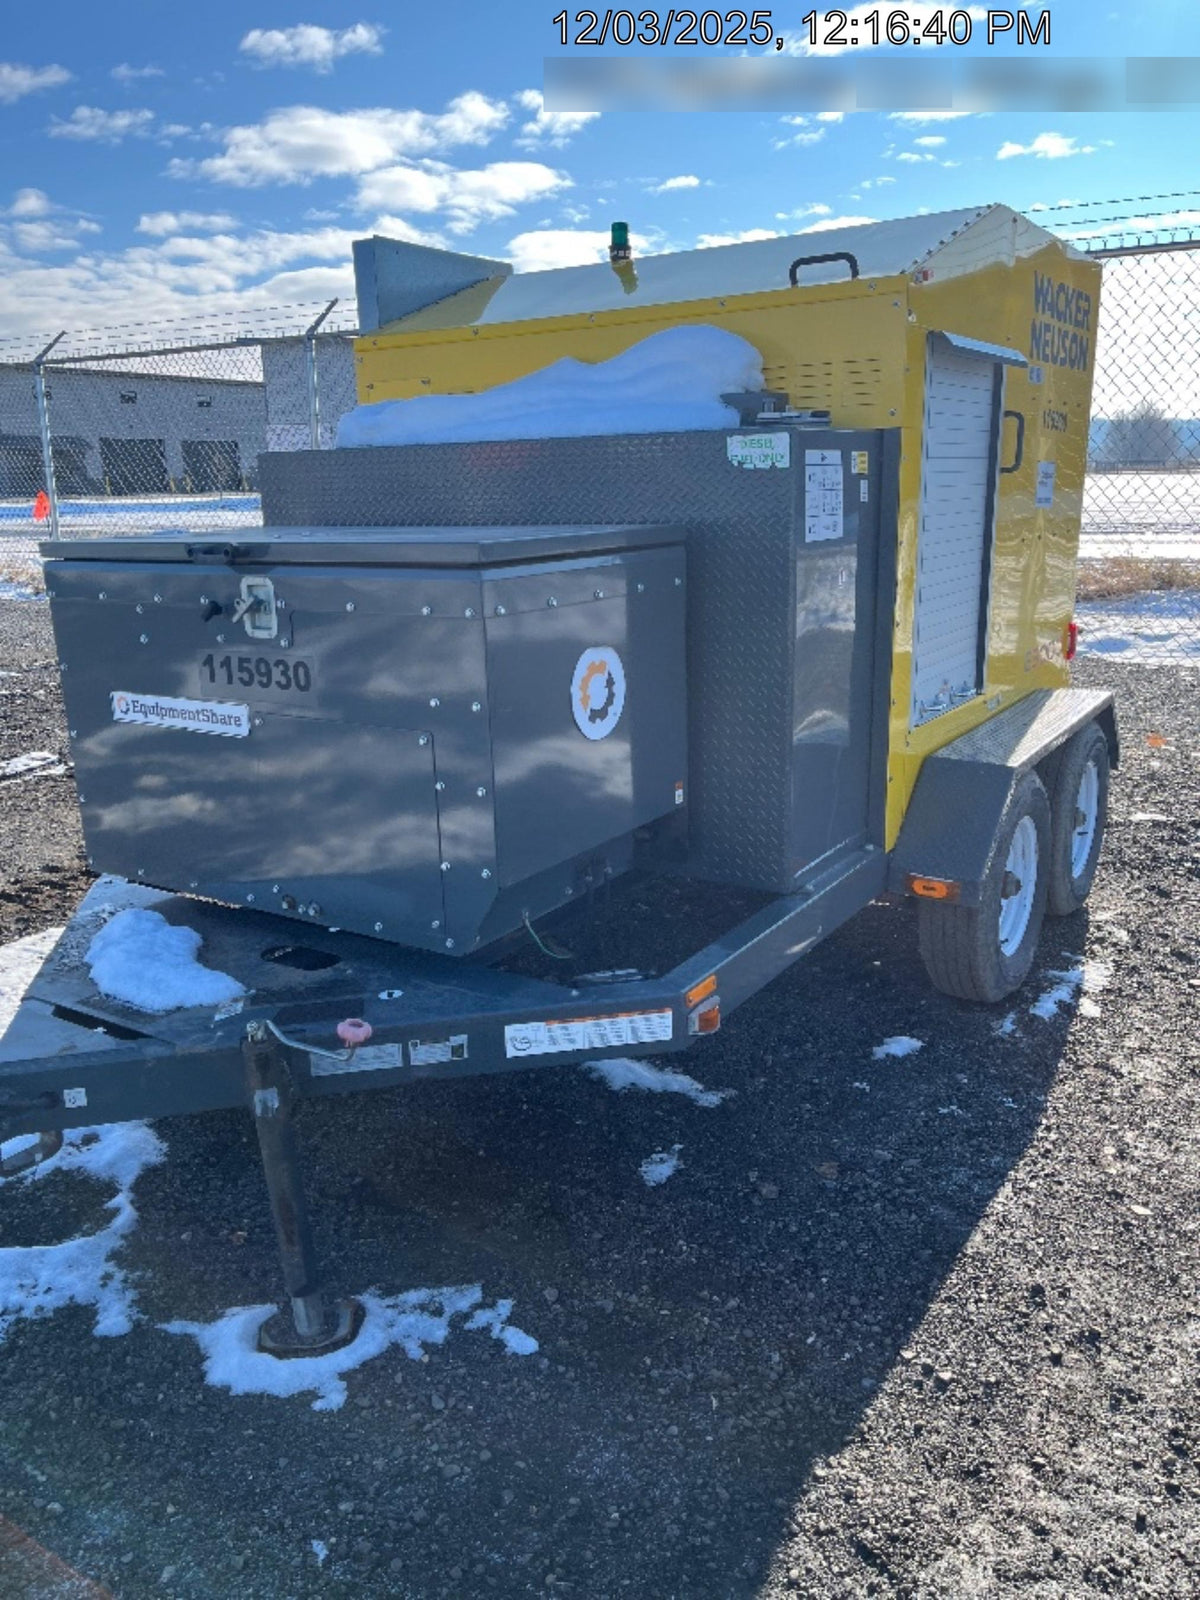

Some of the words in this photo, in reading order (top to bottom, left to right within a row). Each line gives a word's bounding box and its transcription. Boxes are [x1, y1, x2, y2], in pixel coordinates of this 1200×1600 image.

[1033, 269, 1091, 331] WACKER
[1029, 318, 1089, 371] NEUSON
[202, 653, 312, 692] 115930
[131, 699, 243, 727] EquipmentShare
